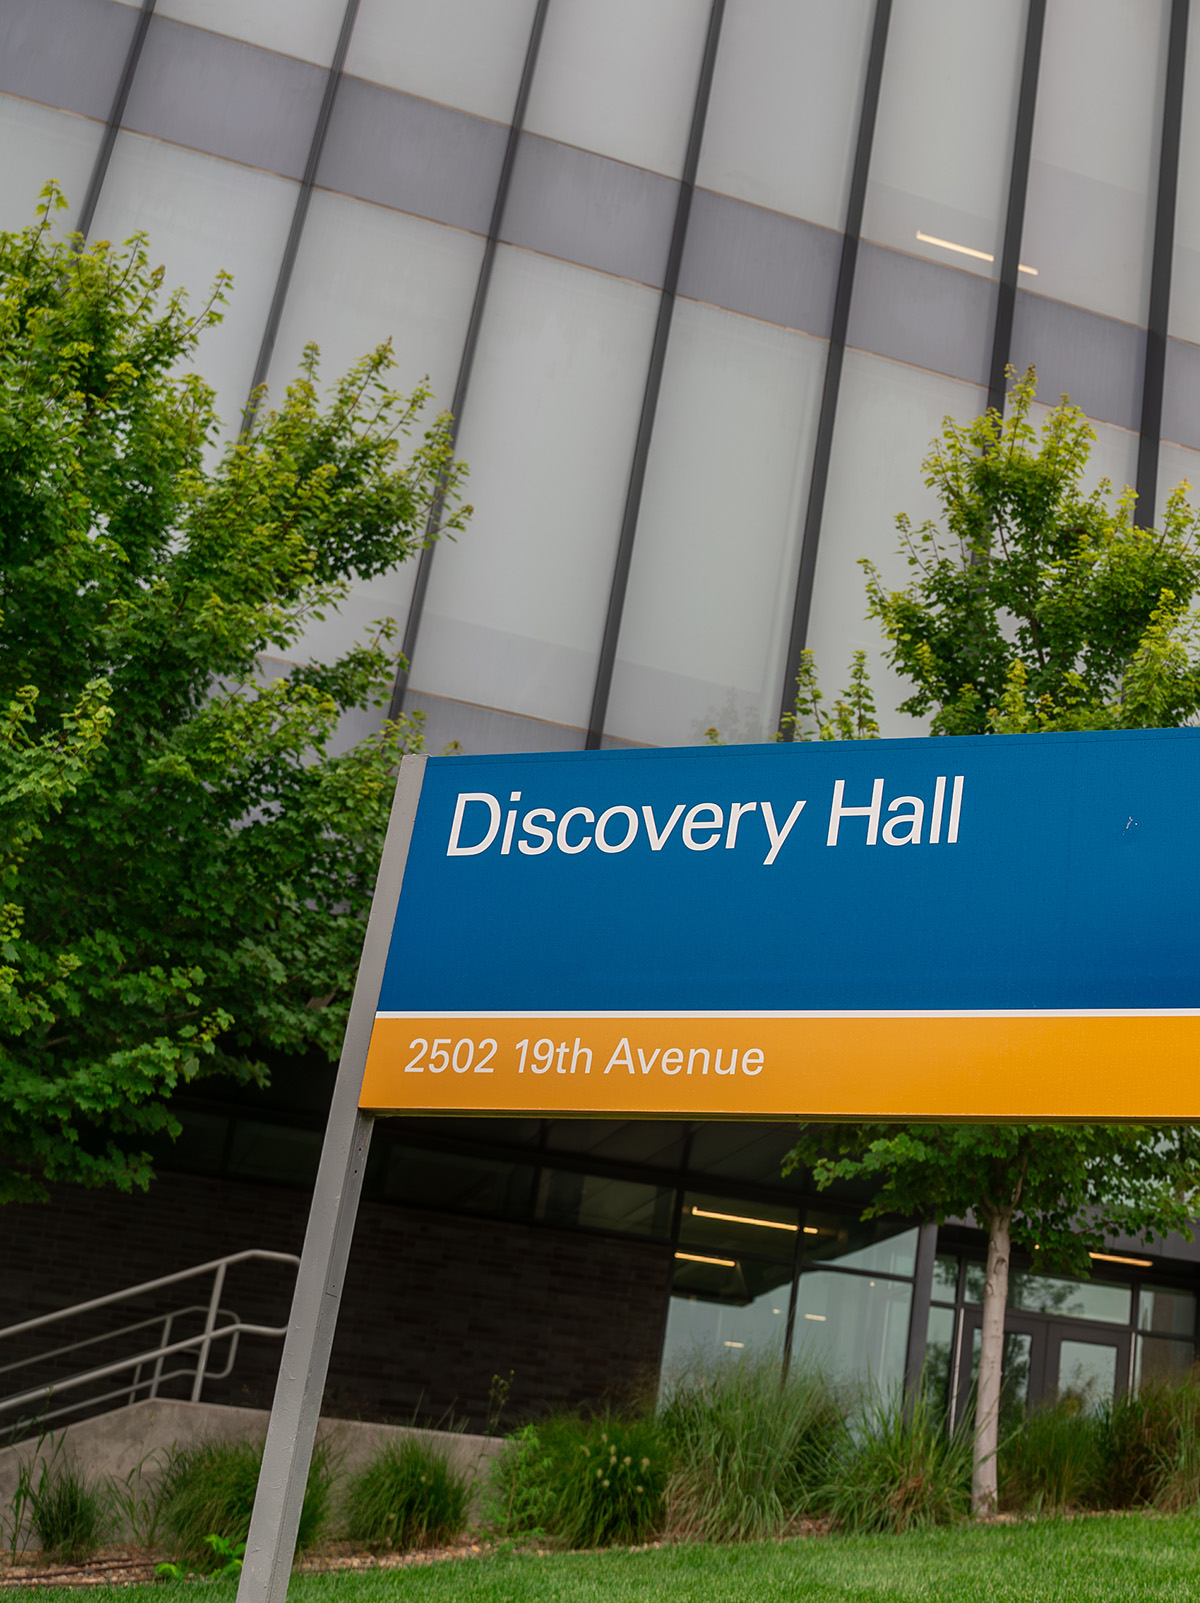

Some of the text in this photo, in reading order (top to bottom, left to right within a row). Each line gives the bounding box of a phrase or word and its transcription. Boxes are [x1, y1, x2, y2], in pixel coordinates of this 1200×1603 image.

[446, 775, 965, 866] Discovery Hall
[404, 1037, 765, 1076] 2502 19th Avenue
